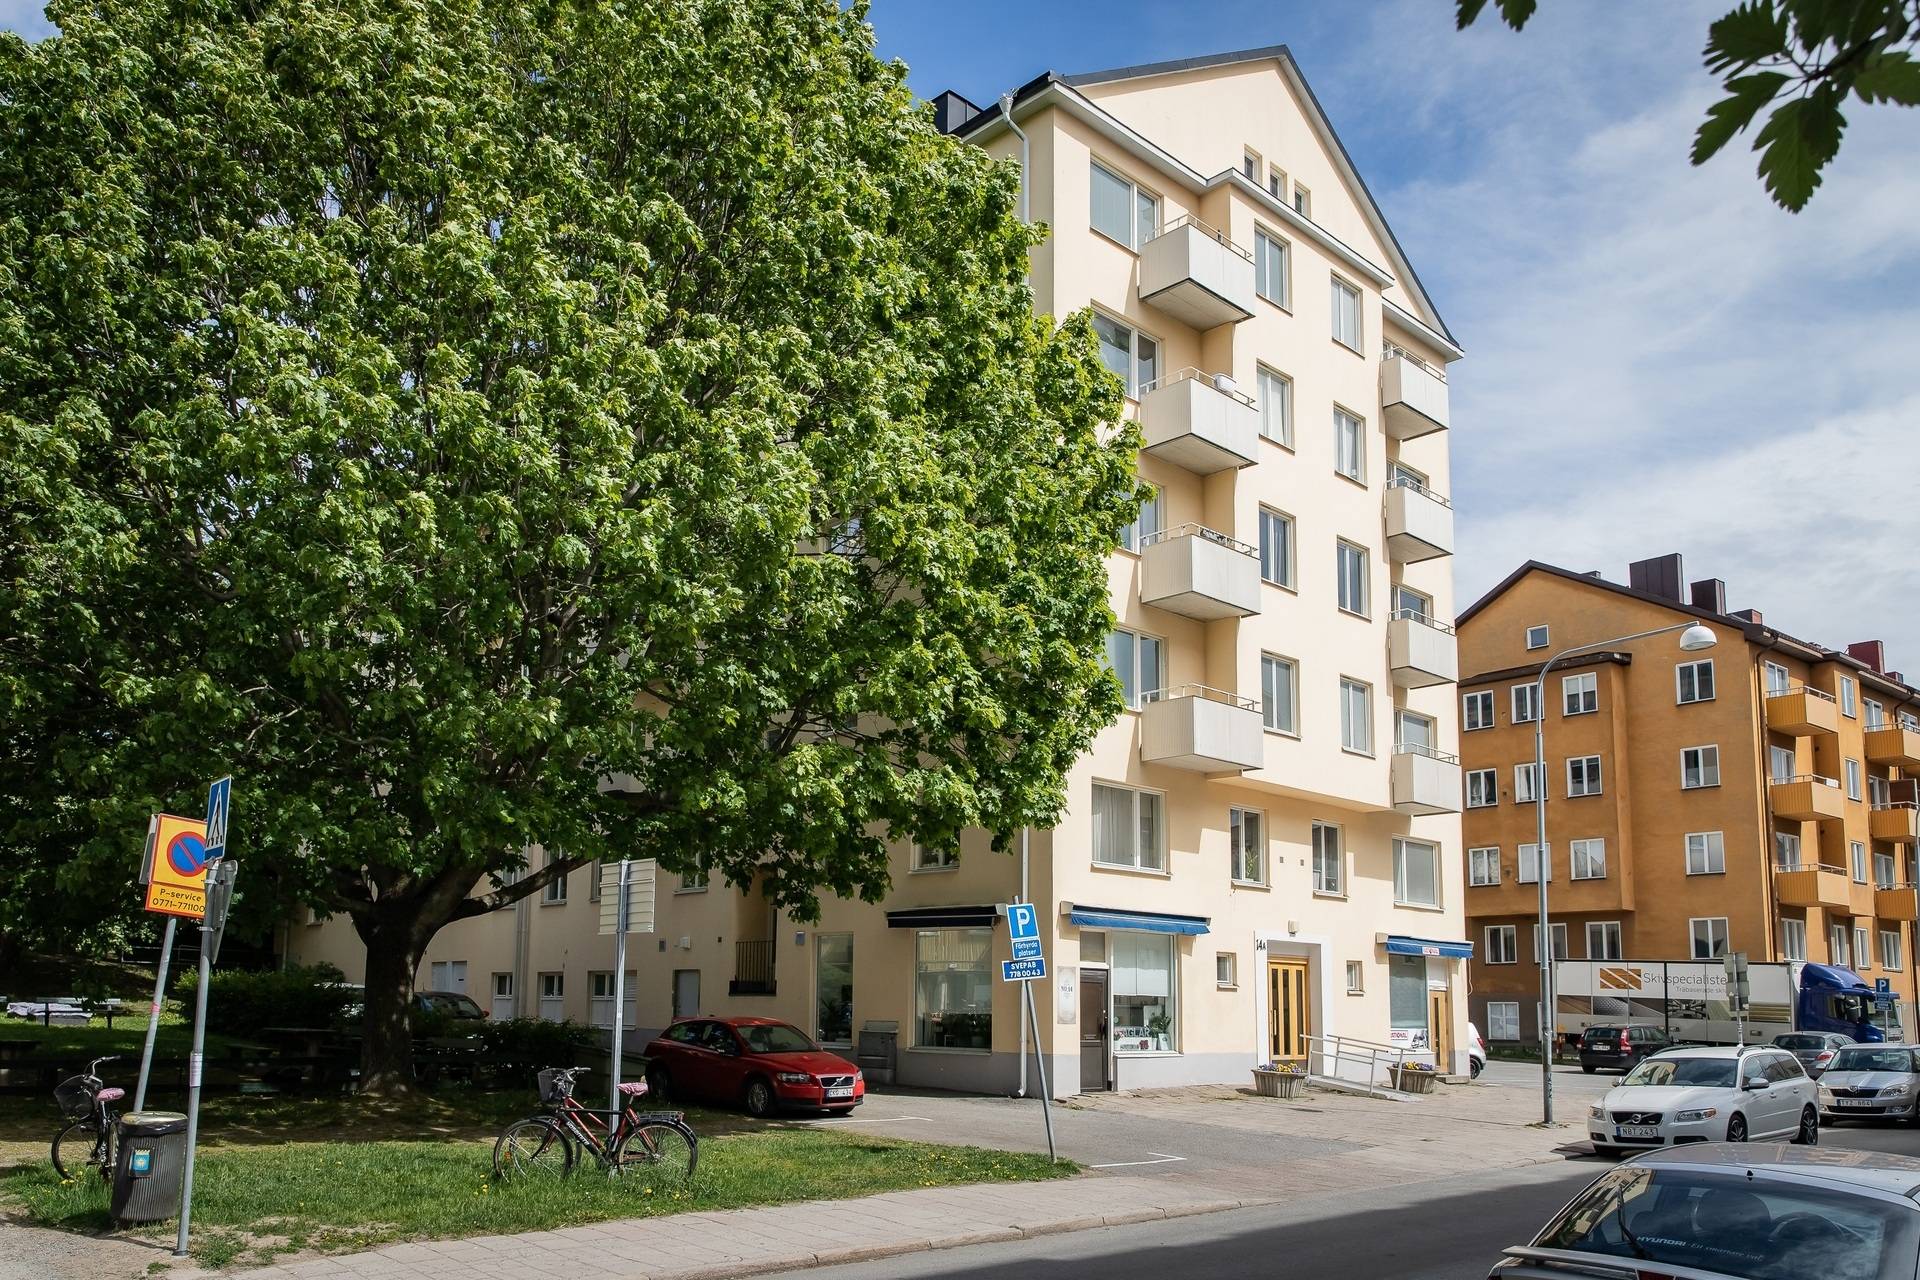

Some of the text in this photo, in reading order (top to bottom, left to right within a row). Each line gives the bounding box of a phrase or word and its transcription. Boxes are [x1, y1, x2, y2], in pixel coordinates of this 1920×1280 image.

[160, 888, 202, 902] P-service
[152, 897, 205, 912] 0771-771100
[1016, 908, 1030, 936] P
[1018, 949, 1037, 958] platser
[1643, 972, 1728, 987] Skivspecialiste
[1879, 979, 1887, 992] P
[1636, 1235, 1687, 1247] HYUNDAI
